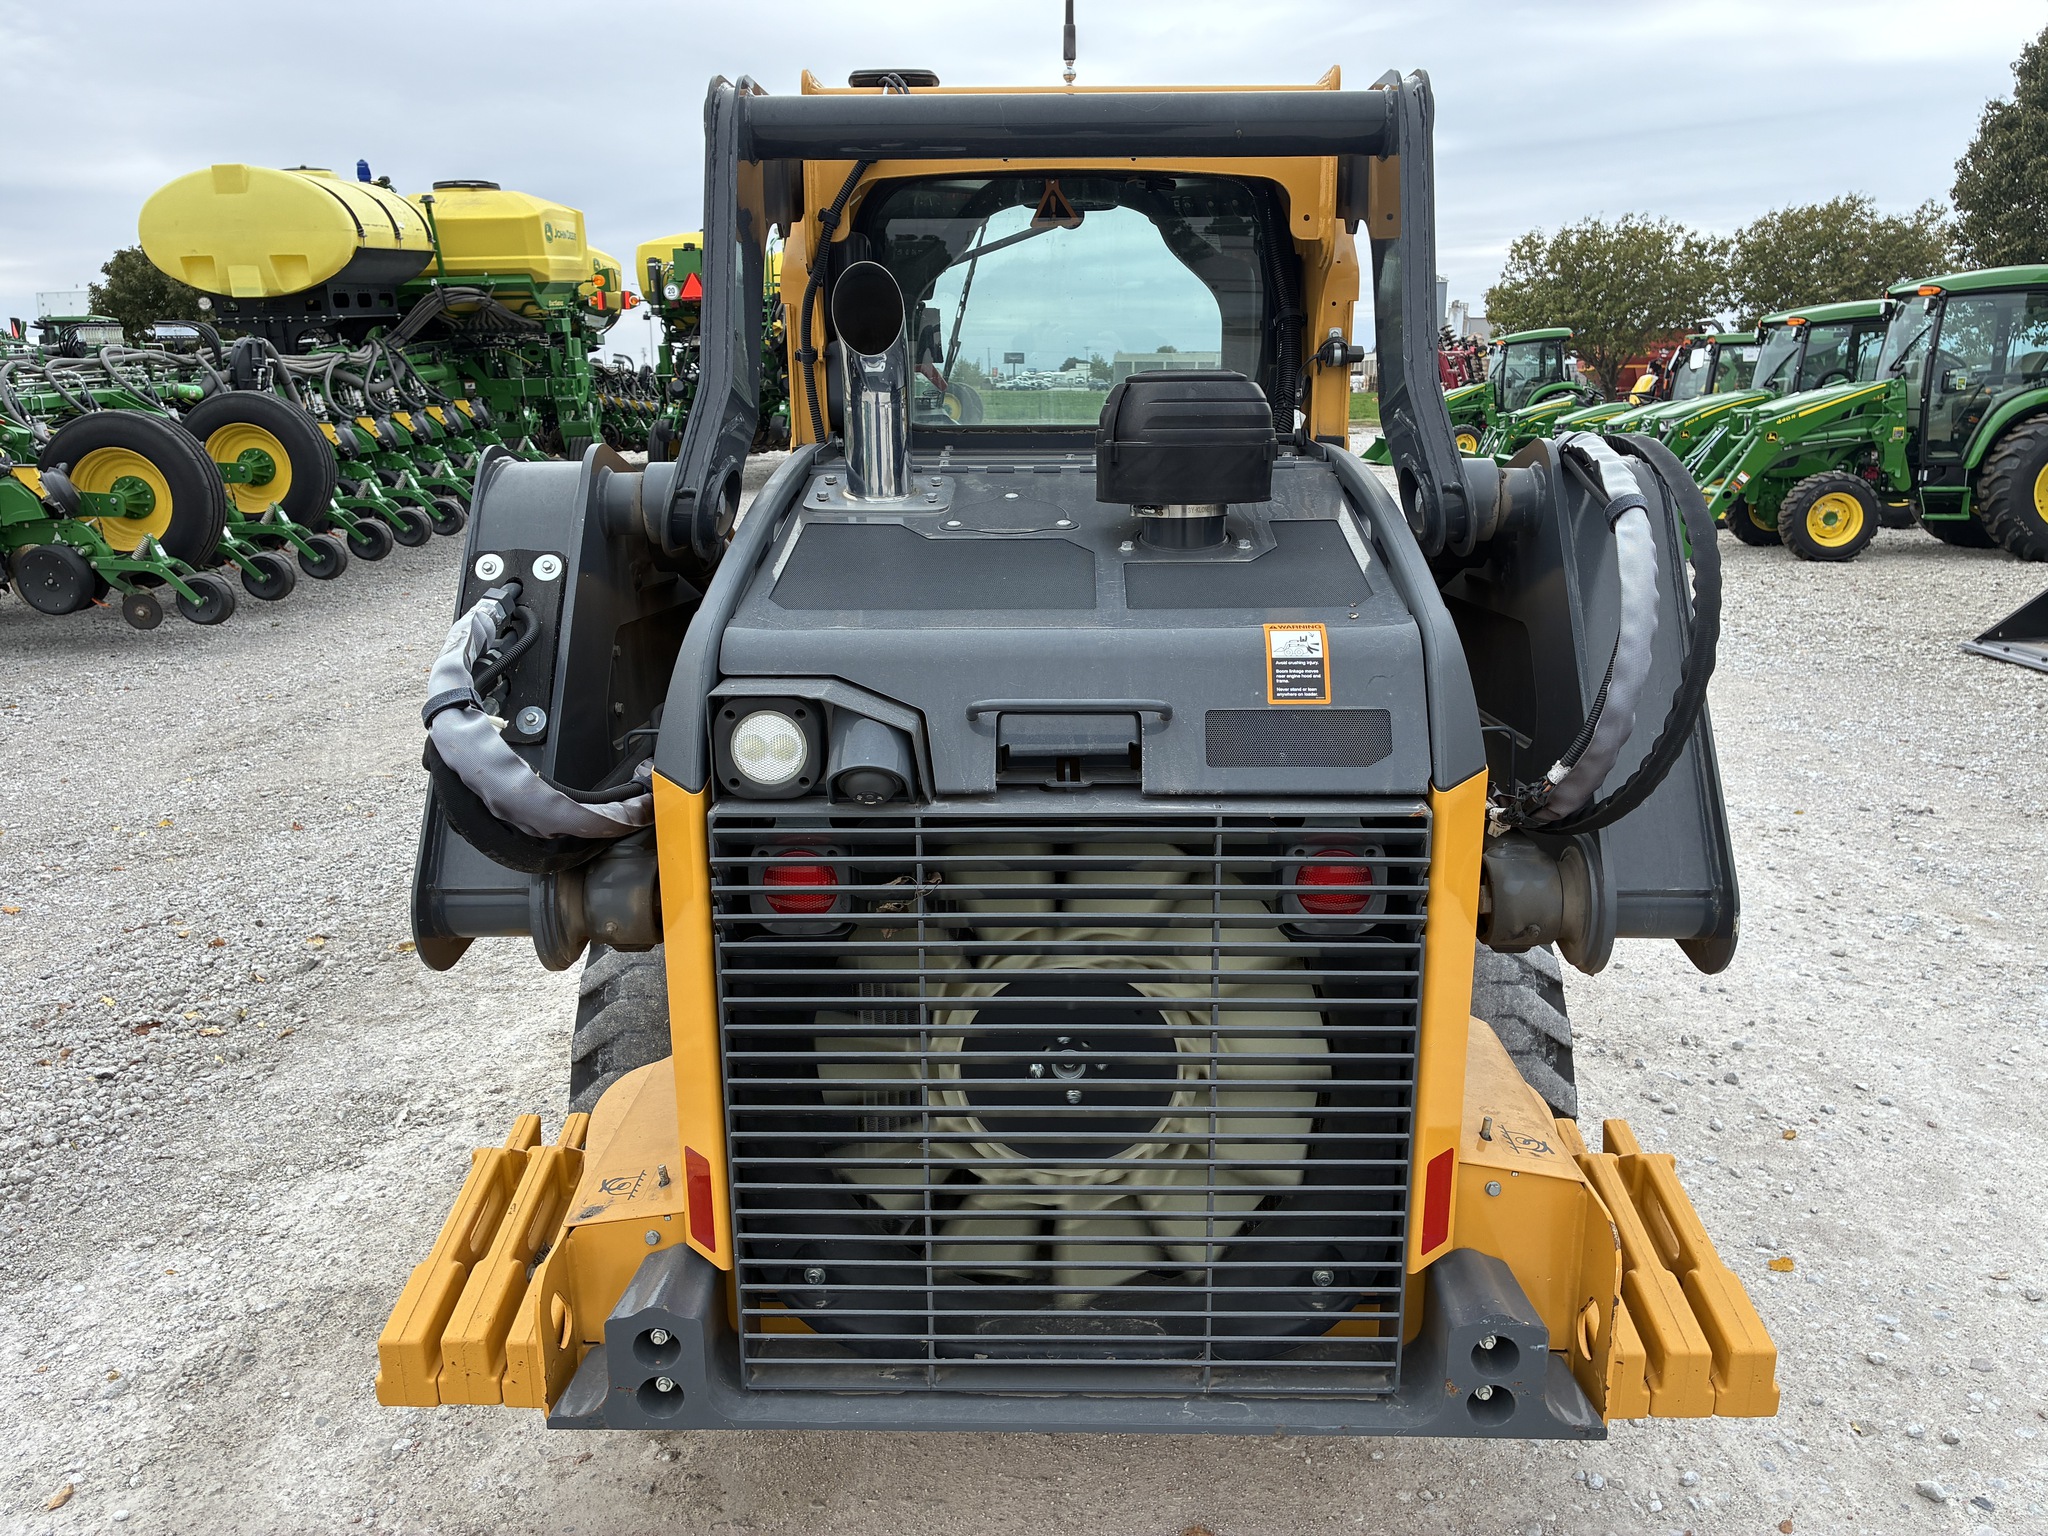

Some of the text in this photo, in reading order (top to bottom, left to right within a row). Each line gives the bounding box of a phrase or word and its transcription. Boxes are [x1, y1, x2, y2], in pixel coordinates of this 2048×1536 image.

[554, 228, 576, 241] JOHN DEERE
[667, 287, 676, 295] 20
